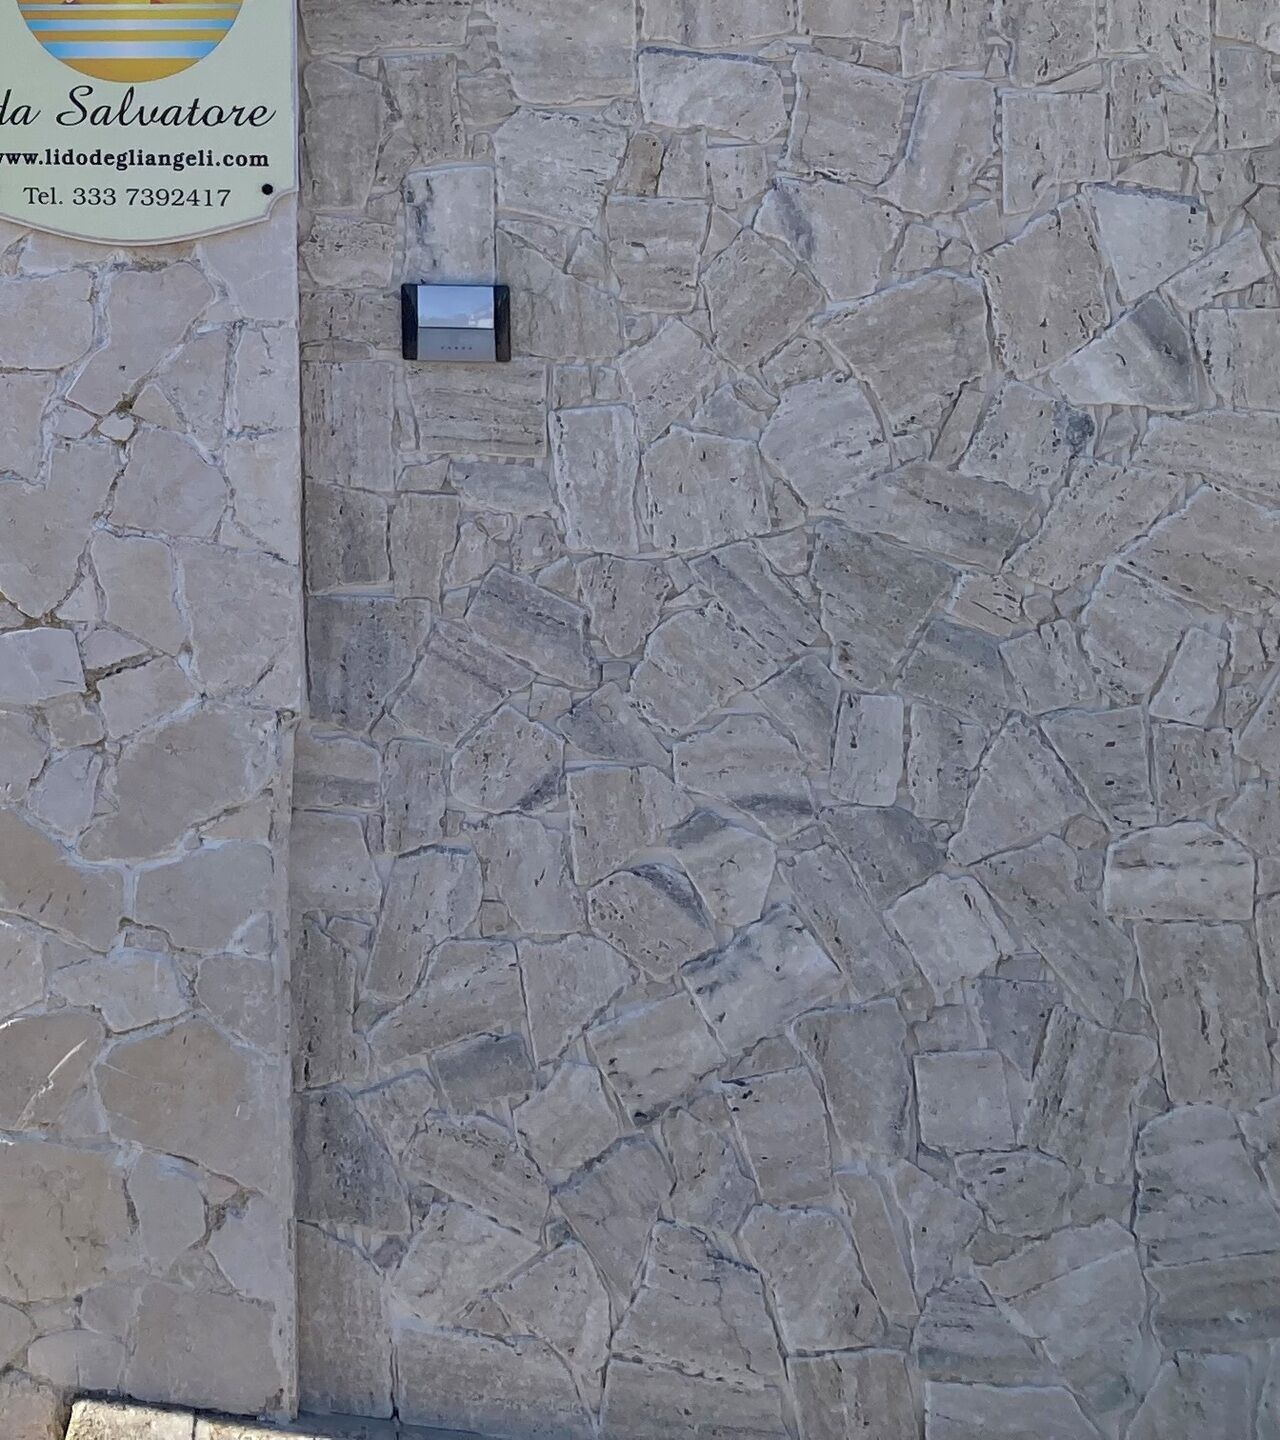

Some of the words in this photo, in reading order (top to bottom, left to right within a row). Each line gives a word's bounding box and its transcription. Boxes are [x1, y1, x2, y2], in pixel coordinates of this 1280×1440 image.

[56, 84, 277, 128] Salvatore
[23, 186, 64, 206] Tel.
[73, 187, 116, 206] 333
[125, 188, 231, 208] 7392417
